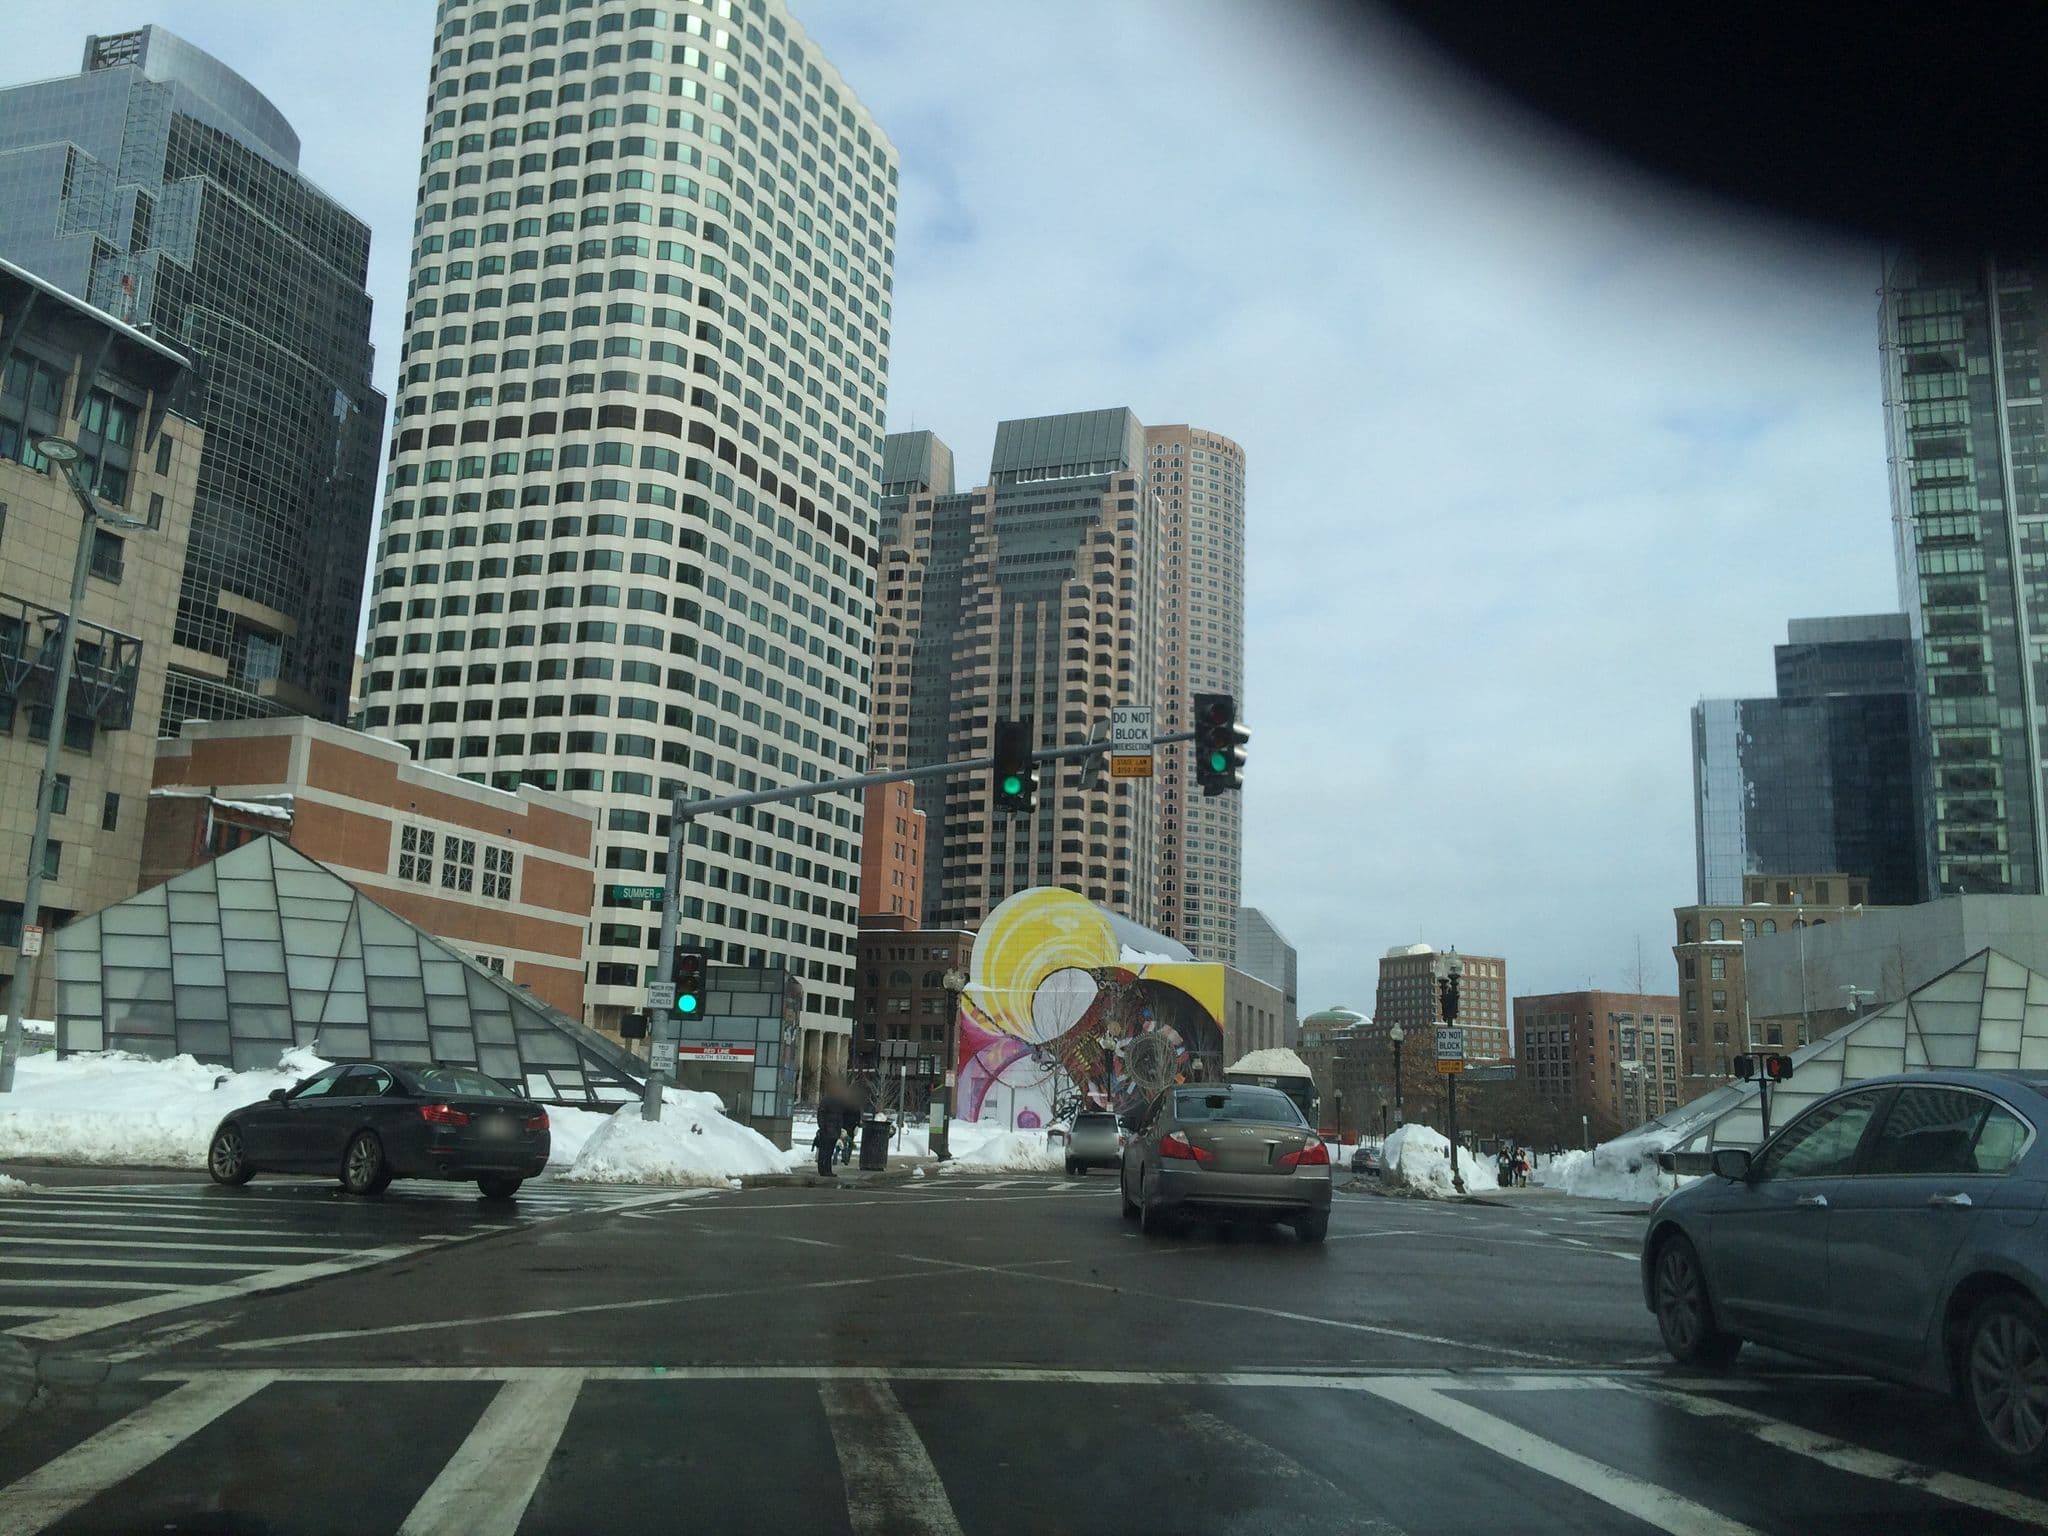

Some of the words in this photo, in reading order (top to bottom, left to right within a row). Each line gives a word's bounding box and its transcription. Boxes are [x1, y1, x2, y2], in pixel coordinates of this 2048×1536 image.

[1113, 712, 1127, 723] DO
[1131, 712, 1150, 723] NOT
[1115, 728, 1149, 740] BLOCK
[623, 887, 655, 899] SUMMER
[1437, 1031, 1447, 1039] DO
[1449, 1031, 1461, 1040] NOT
[1439, 1042, 1460, 1050] BLOCK
